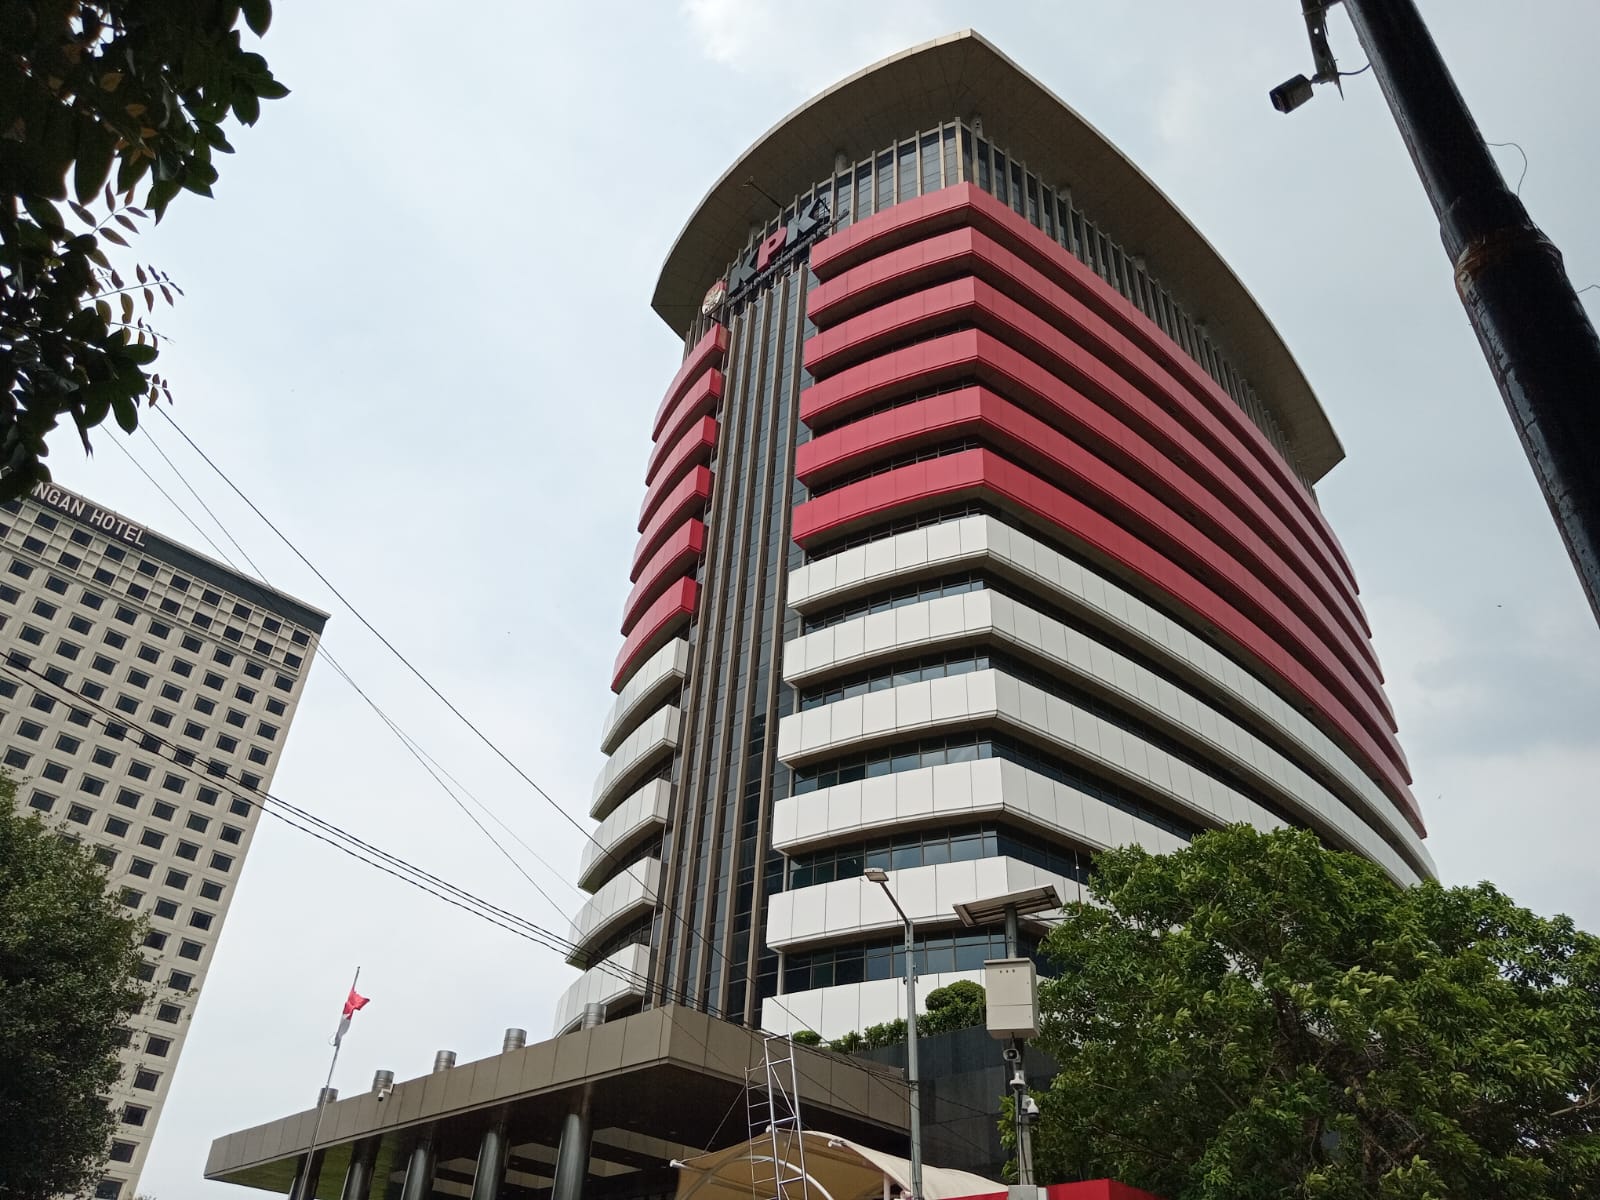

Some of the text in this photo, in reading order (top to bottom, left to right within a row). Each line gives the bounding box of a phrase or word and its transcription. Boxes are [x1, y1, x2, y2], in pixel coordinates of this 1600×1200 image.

[728, 198, 819, 295] KPK
[31, 482, 145, 547] NGAN HOTEL
